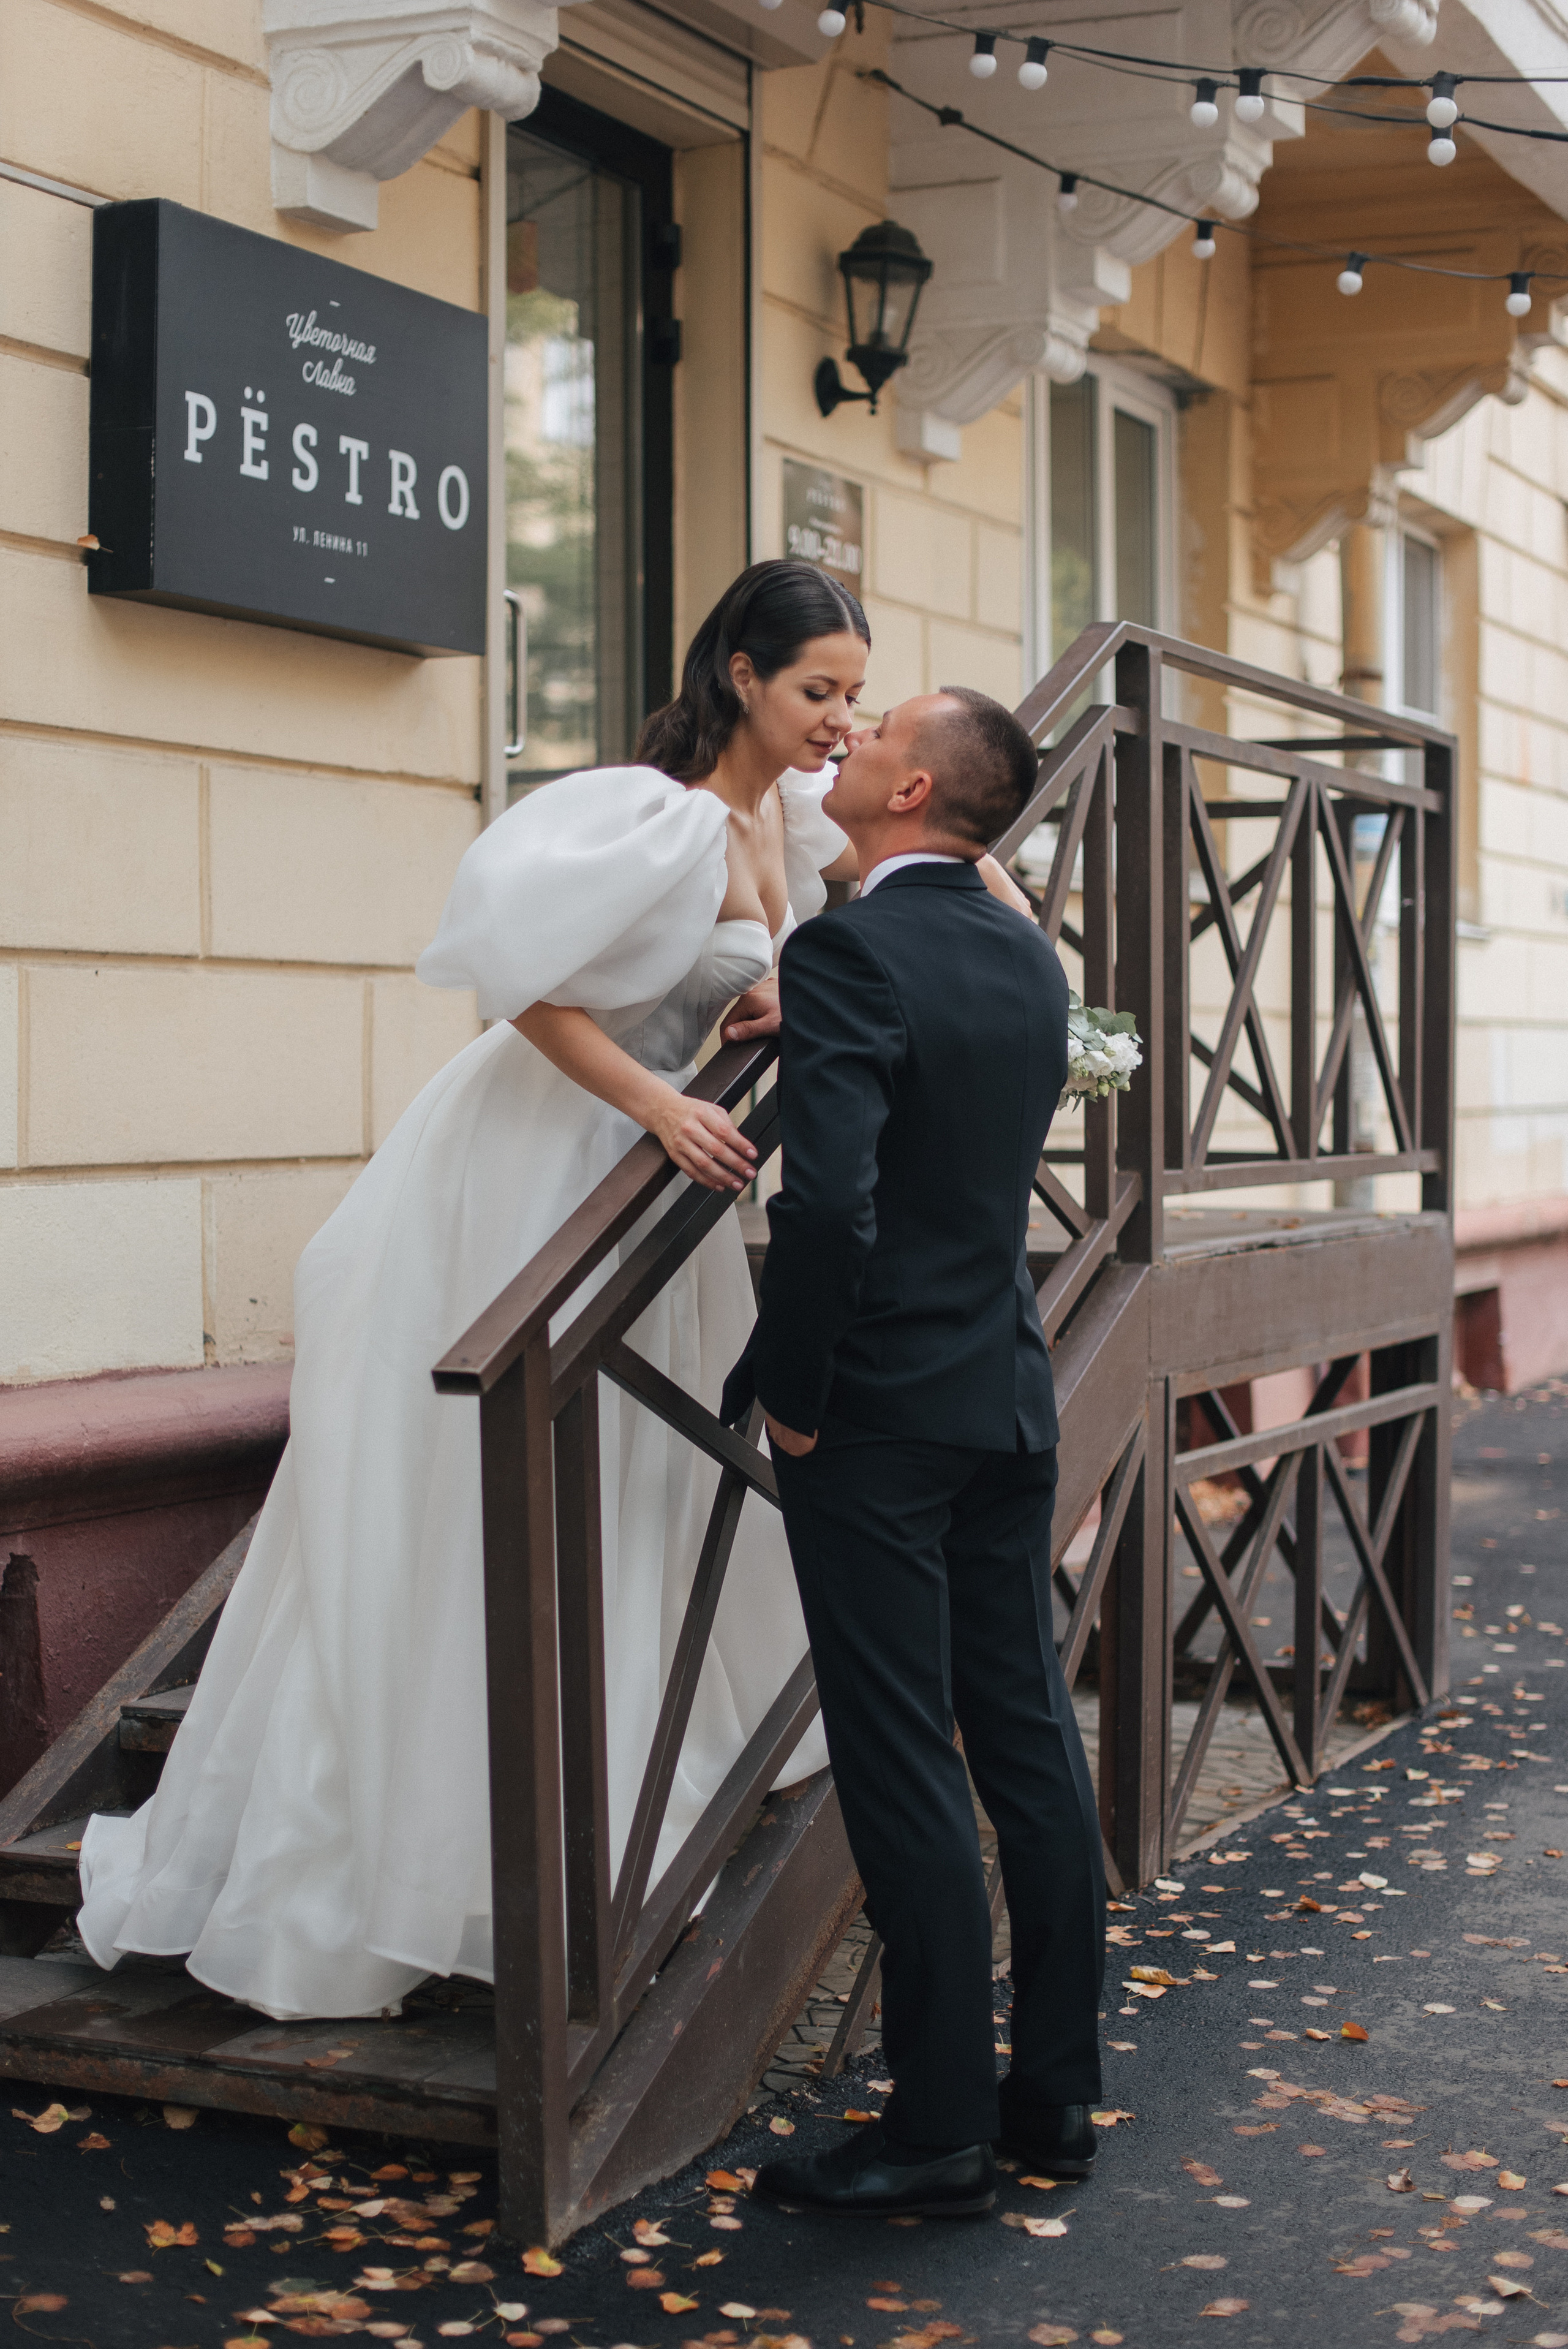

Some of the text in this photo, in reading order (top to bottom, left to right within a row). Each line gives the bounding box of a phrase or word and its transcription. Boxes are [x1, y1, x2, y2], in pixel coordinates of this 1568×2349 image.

[285, 309, 377, 365] Цветочная
[184, 386, 470, 531] PËSTRO
[293, 526, 368, 557] УЛ. ЛЕНИНА 11
